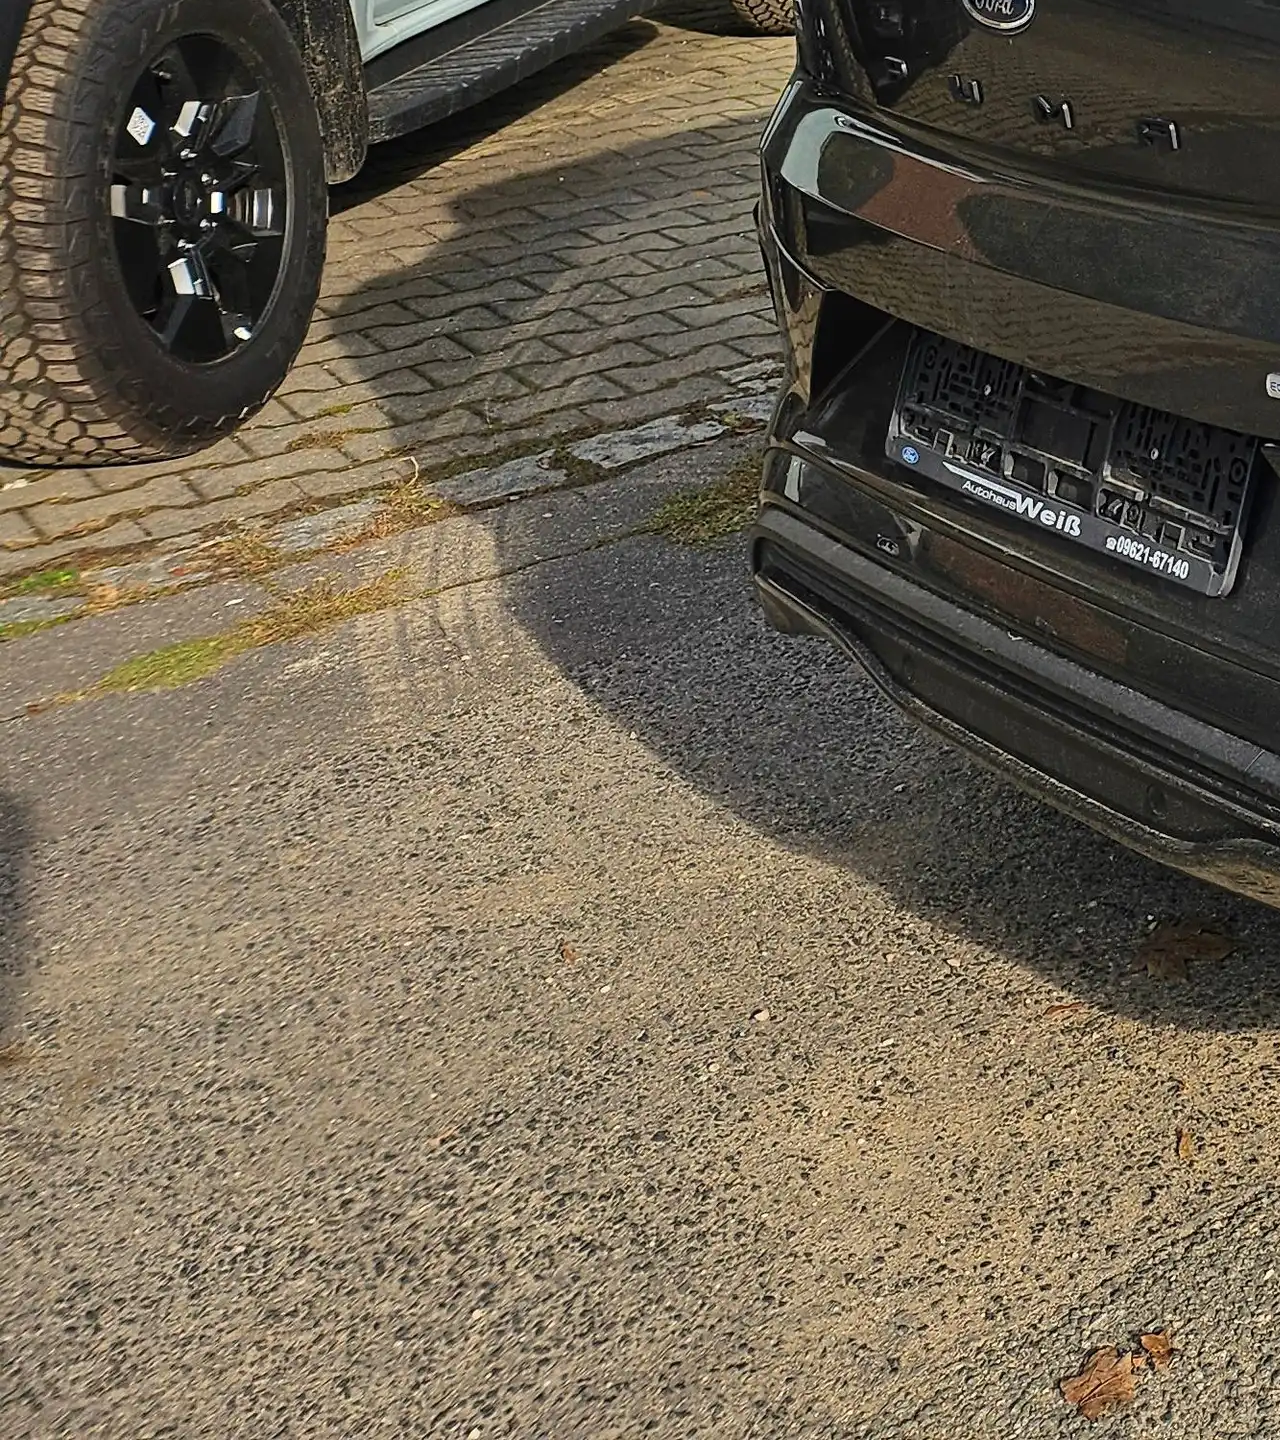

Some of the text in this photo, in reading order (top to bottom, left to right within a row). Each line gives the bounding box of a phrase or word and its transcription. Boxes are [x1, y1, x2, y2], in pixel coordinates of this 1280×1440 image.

[961, 479, 1083, 537] Autohaus Weiß
[1116, 535, 1189, 580] 09621-67140
